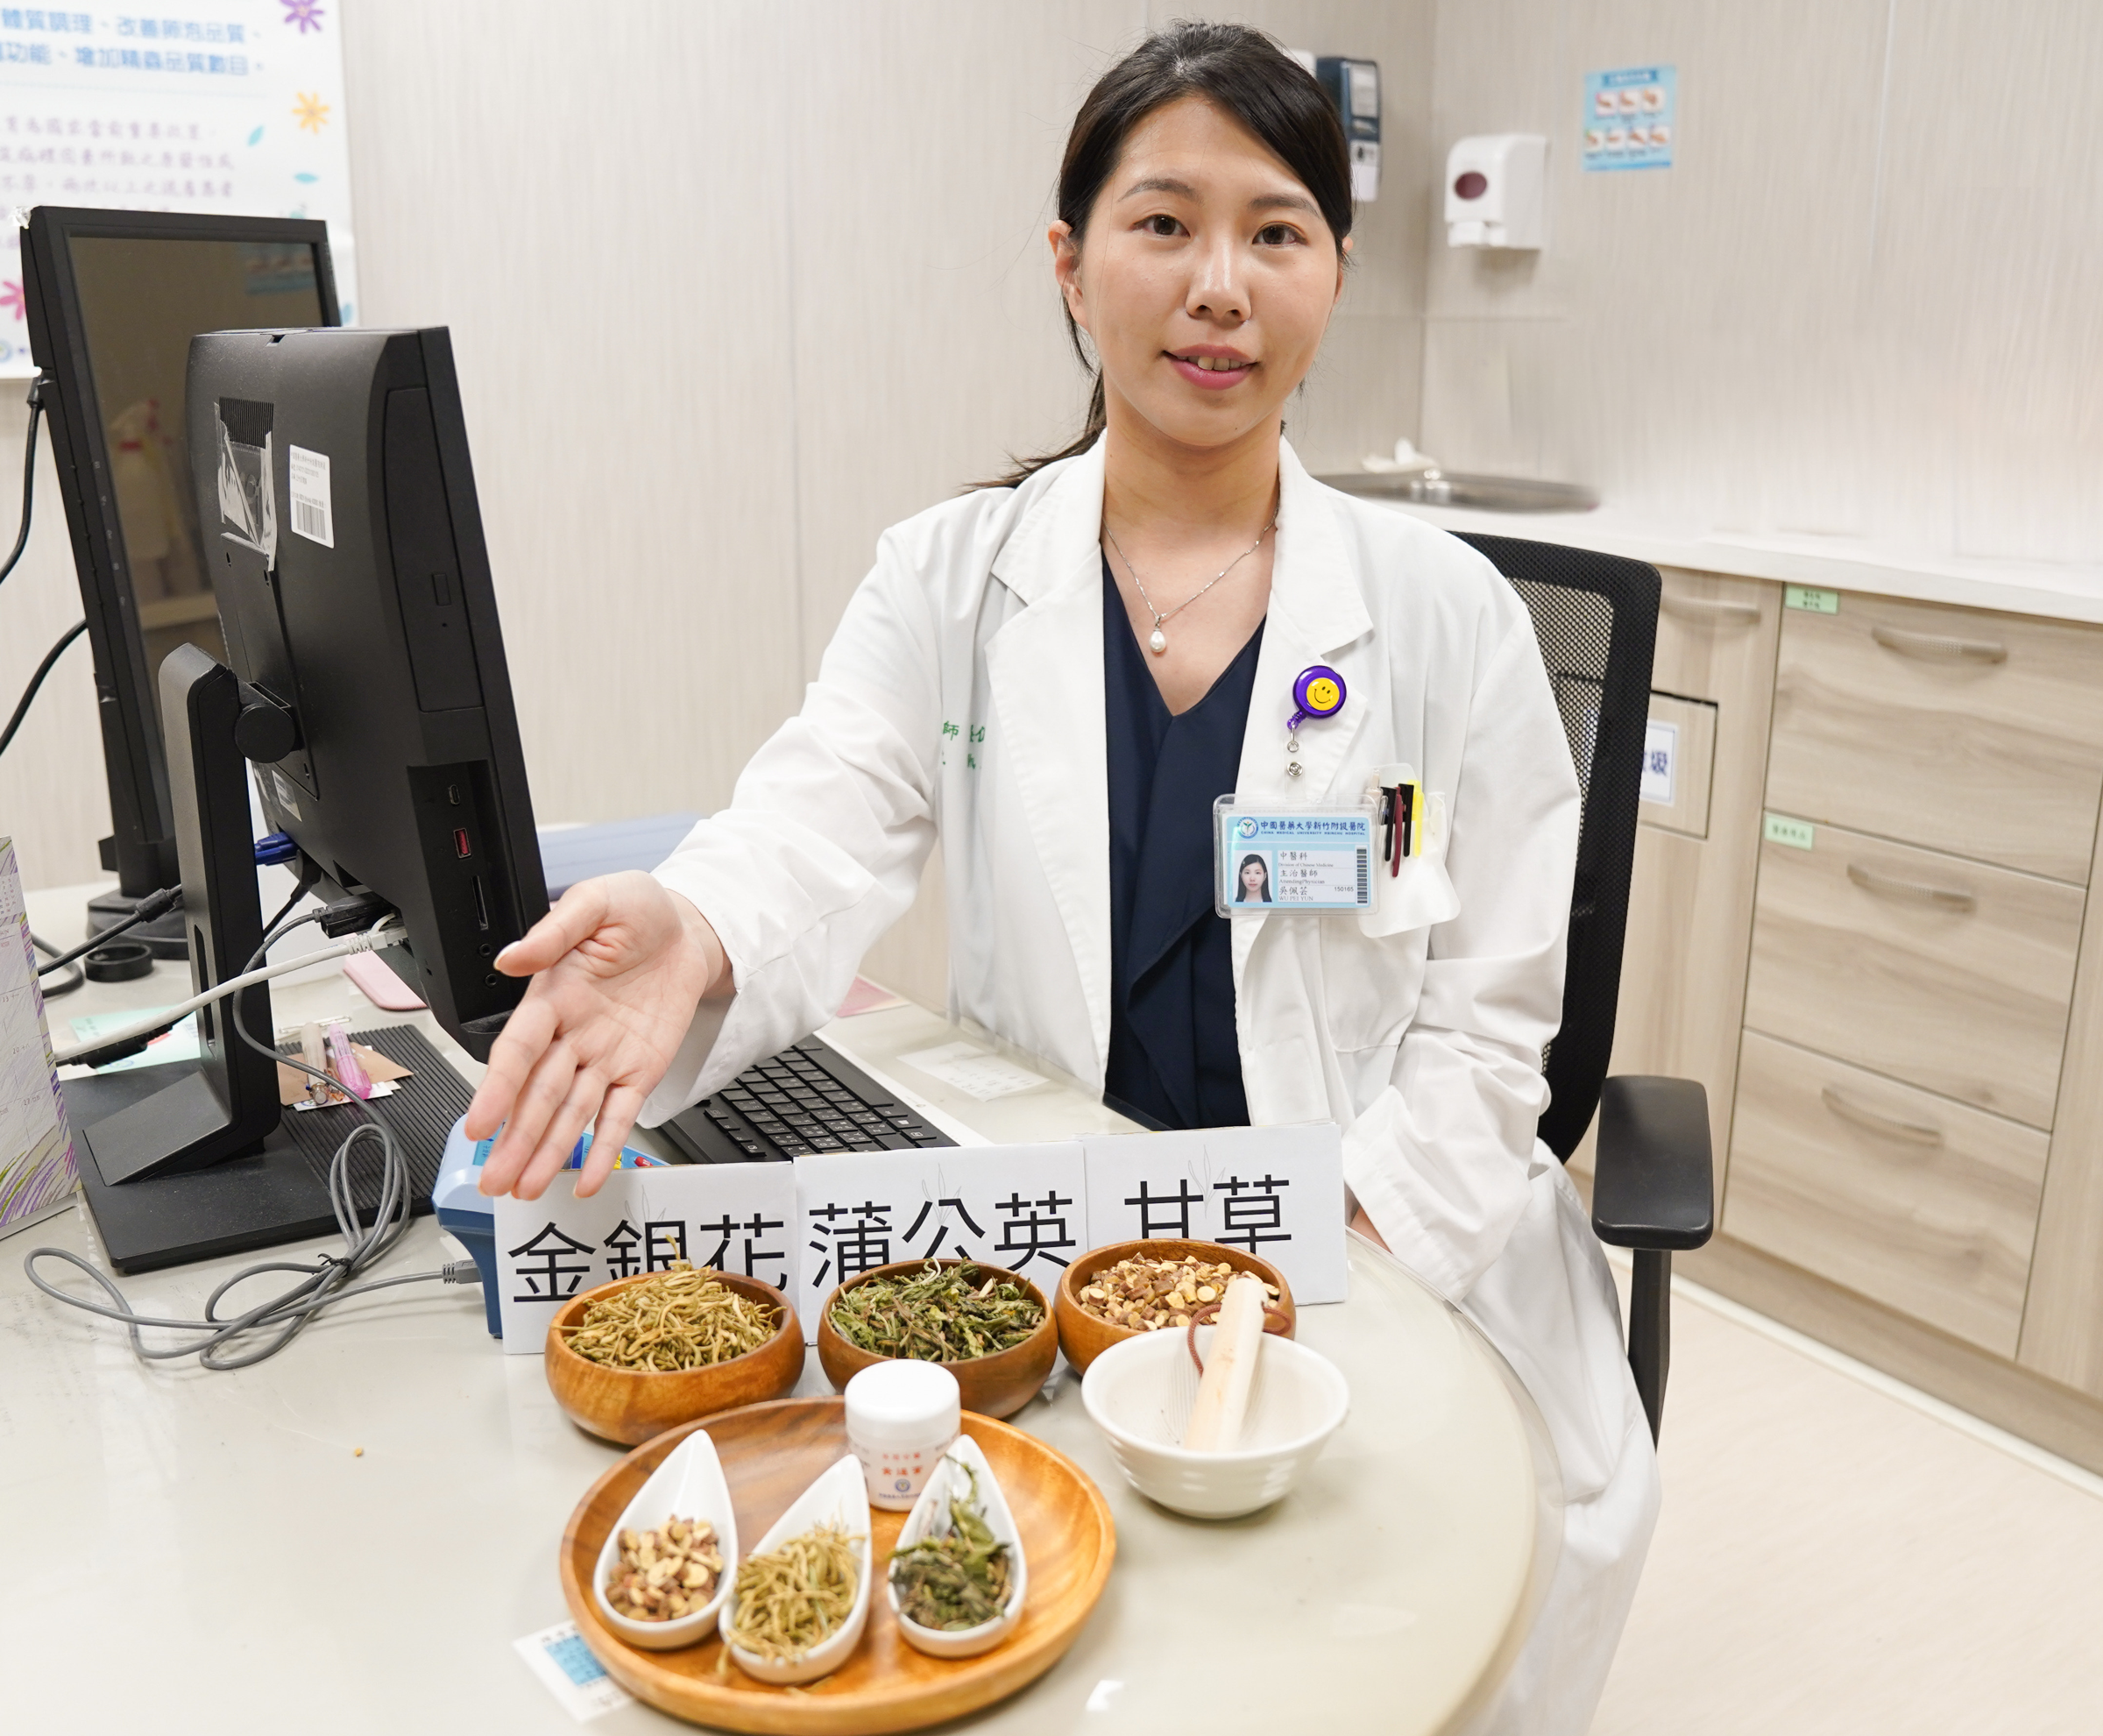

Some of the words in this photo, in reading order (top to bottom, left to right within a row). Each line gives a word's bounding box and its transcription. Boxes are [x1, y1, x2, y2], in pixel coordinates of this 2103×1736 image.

[1260, 820, 1366, 832] 中國醫藥大學新竹附設醫院
[1279, 851, 1308, 861] 中醫科
[1279, 868, 1318, 878] 主治醫師
[1279, 886, 1308, 896] 吳佩芸
[1124, 1174, 1292, 1255] 甘草
[809, 1190, 1076, 1288] 蒲公英
[507, 1213, 788, 1302] 金銀花
